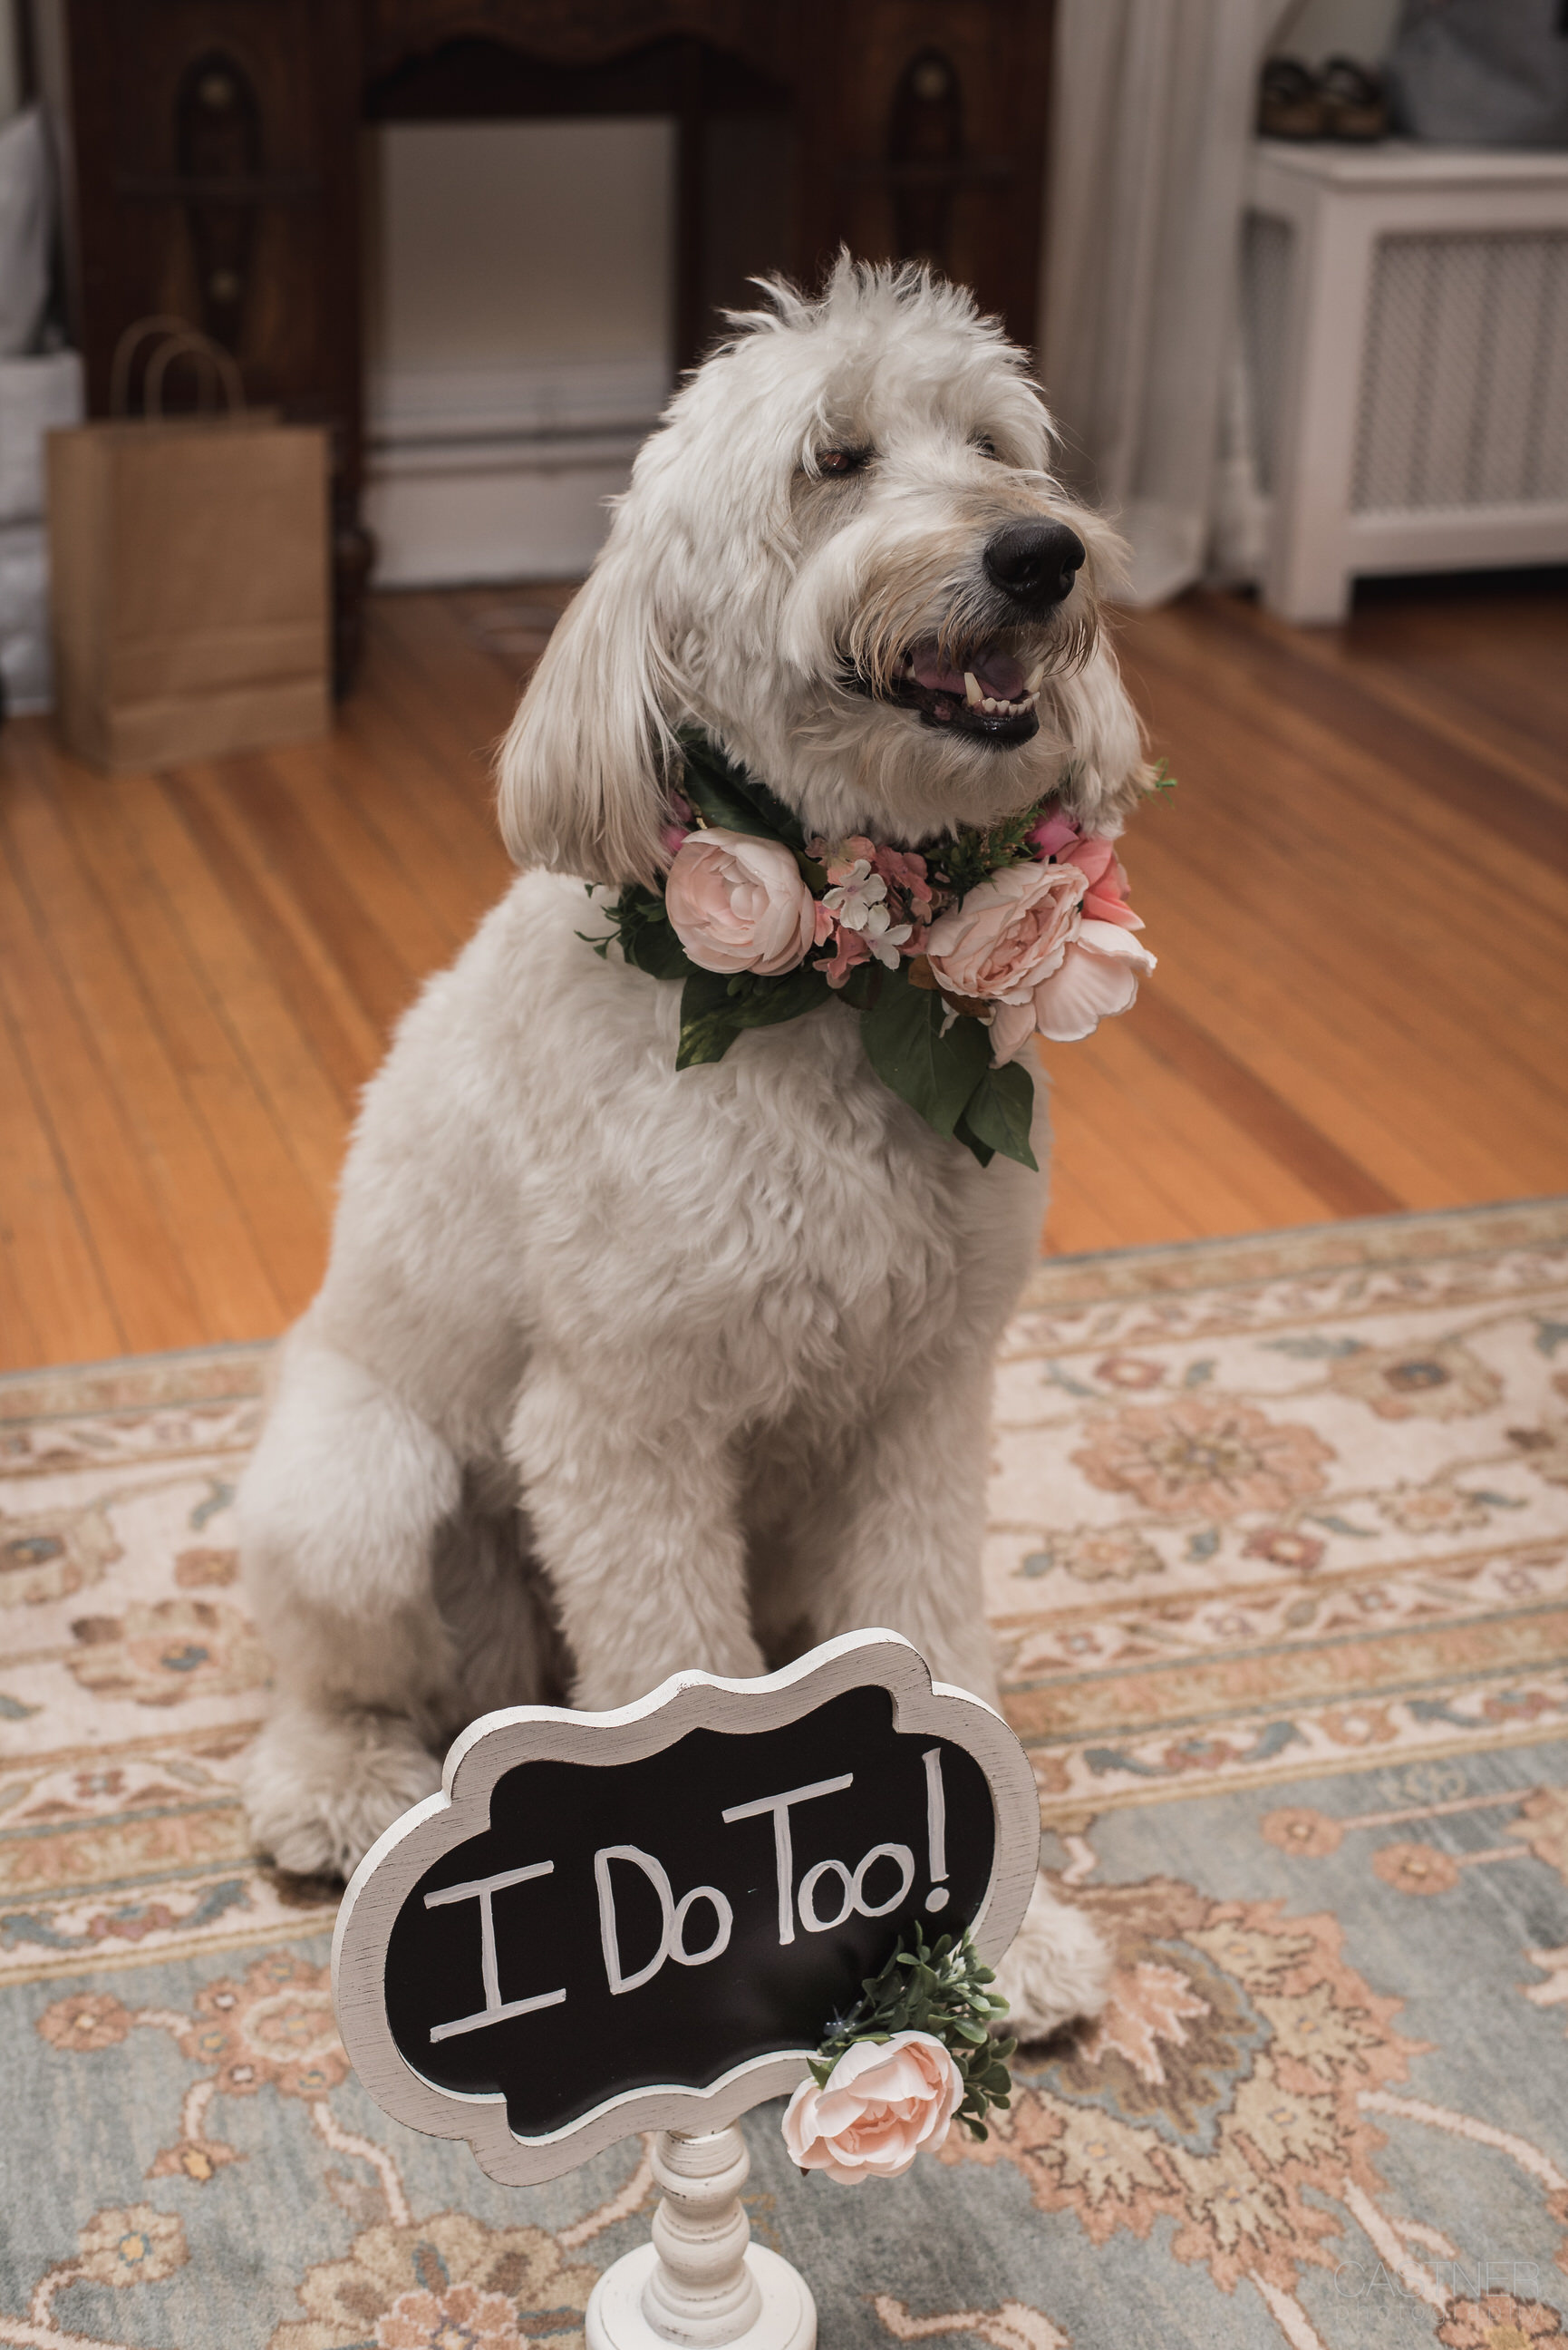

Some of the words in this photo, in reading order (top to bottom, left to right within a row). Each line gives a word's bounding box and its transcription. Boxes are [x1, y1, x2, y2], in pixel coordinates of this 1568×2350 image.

[423, 1860, 566, 2044] I
[594, 1844, 733, 1996] Do
[721, 1747, 950, 1945] Too!
